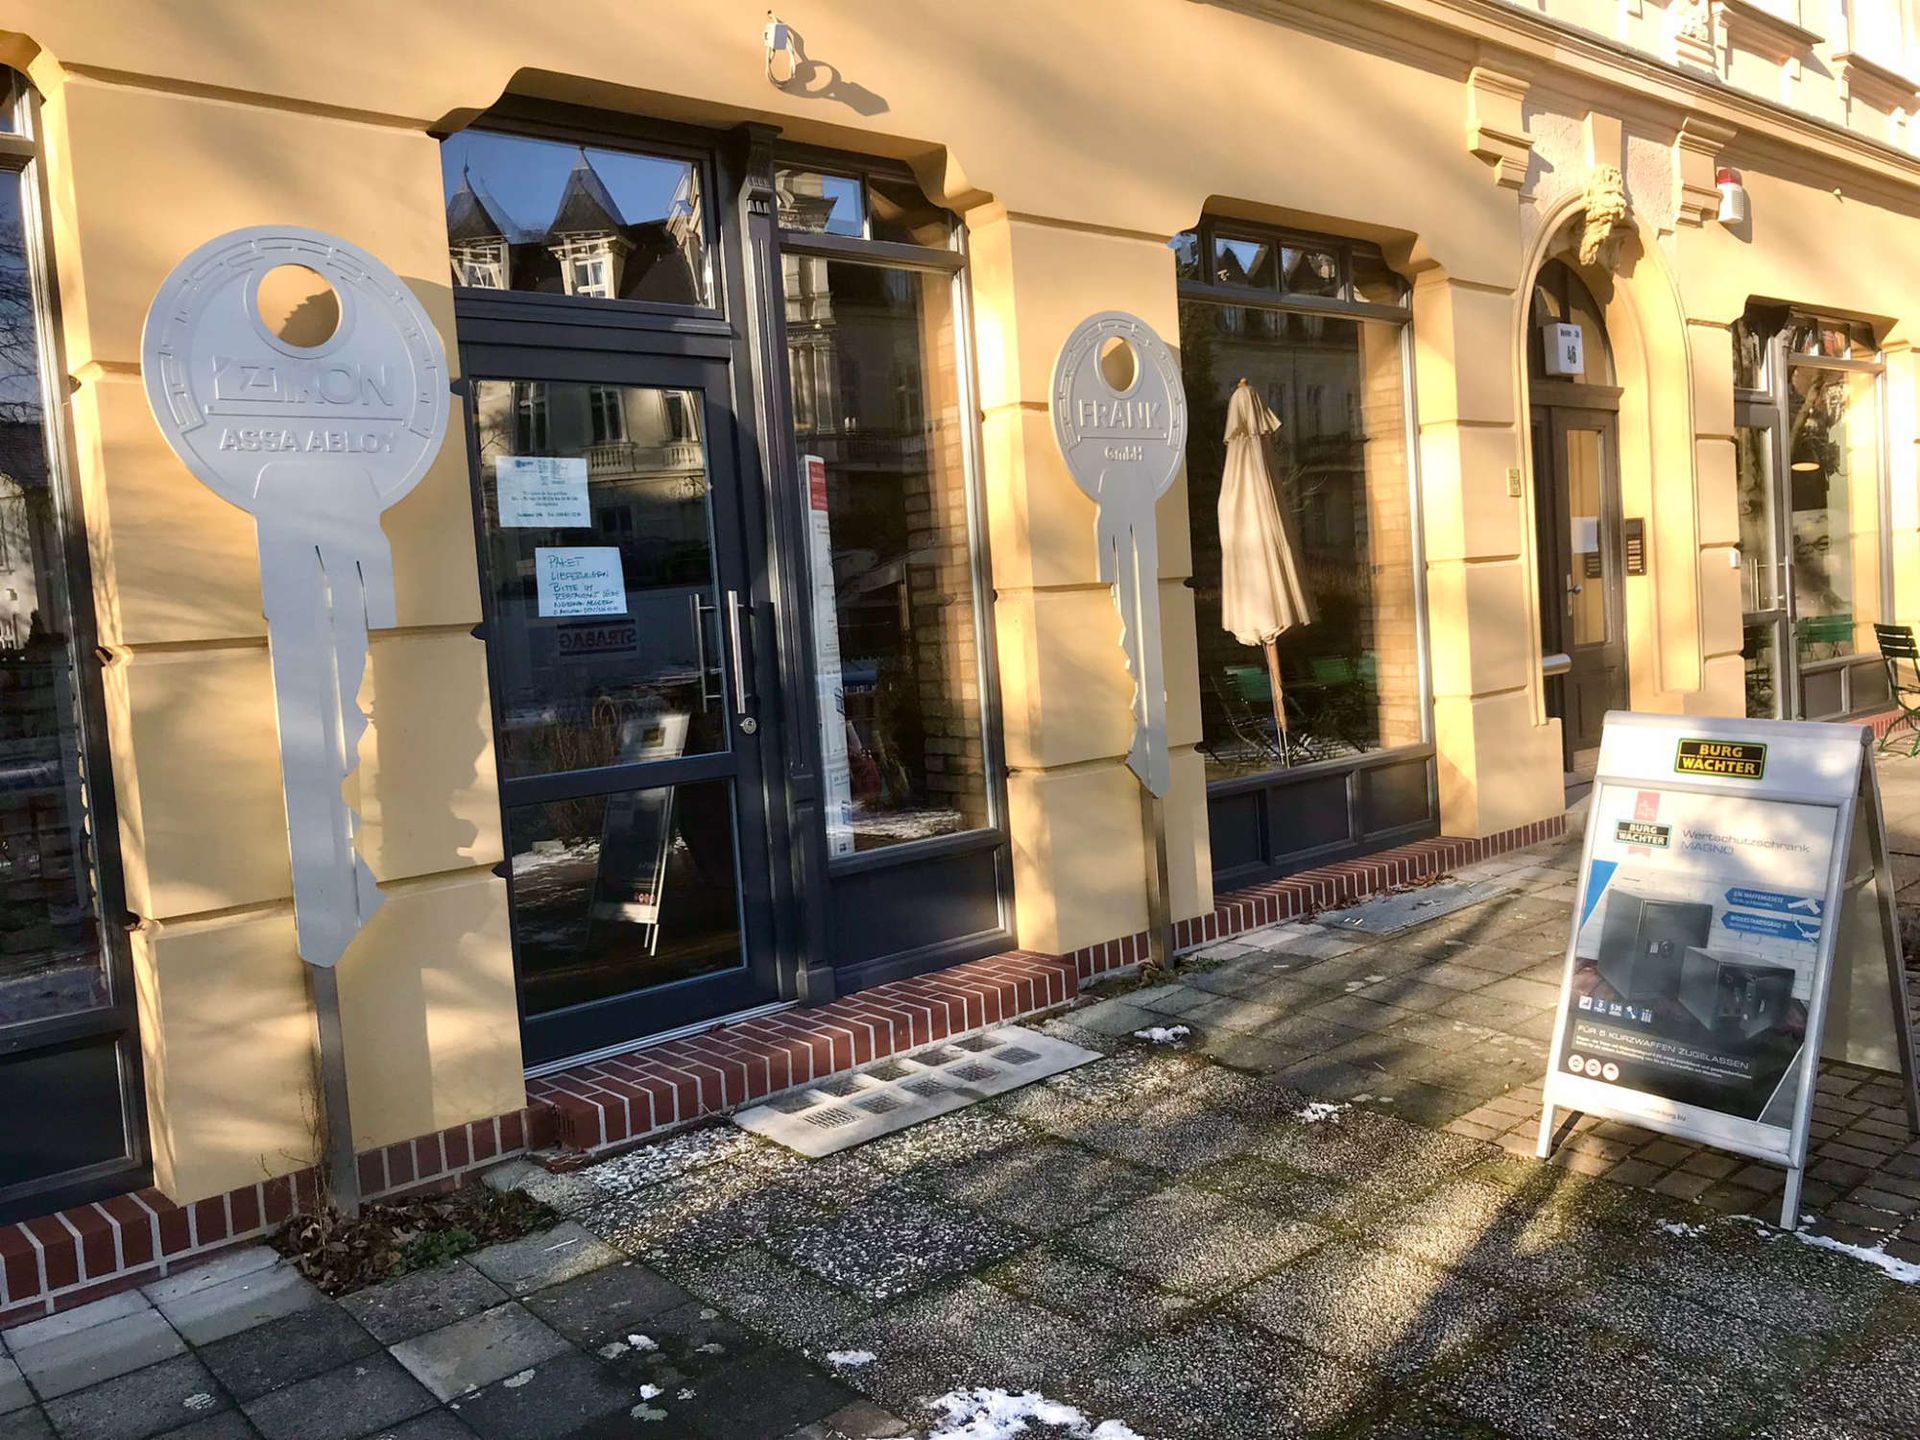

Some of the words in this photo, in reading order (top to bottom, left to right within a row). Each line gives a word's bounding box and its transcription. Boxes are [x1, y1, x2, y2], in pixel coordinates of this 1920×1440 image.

[1078, 398, 1164, 430] FRANK
[219, 428, 301, 453] ASSA
[305, 429, 395, 455] ABLOY
[1103, 445, 1145, 462] GmbH
[547, 553, 585, 569] PAKET
[1699, 743, 1744, 758] BURG
[1682, 754, 1756, 774] WÄCHTER
[1629, 823, 1658, 834] BURG
[1681, 840, 1735, 856] MAGNO
[1608, 1032, 1676, 1053] KURZWAFFEN
[1678, 1047, 1749, 1070] ZUGELASSEN
